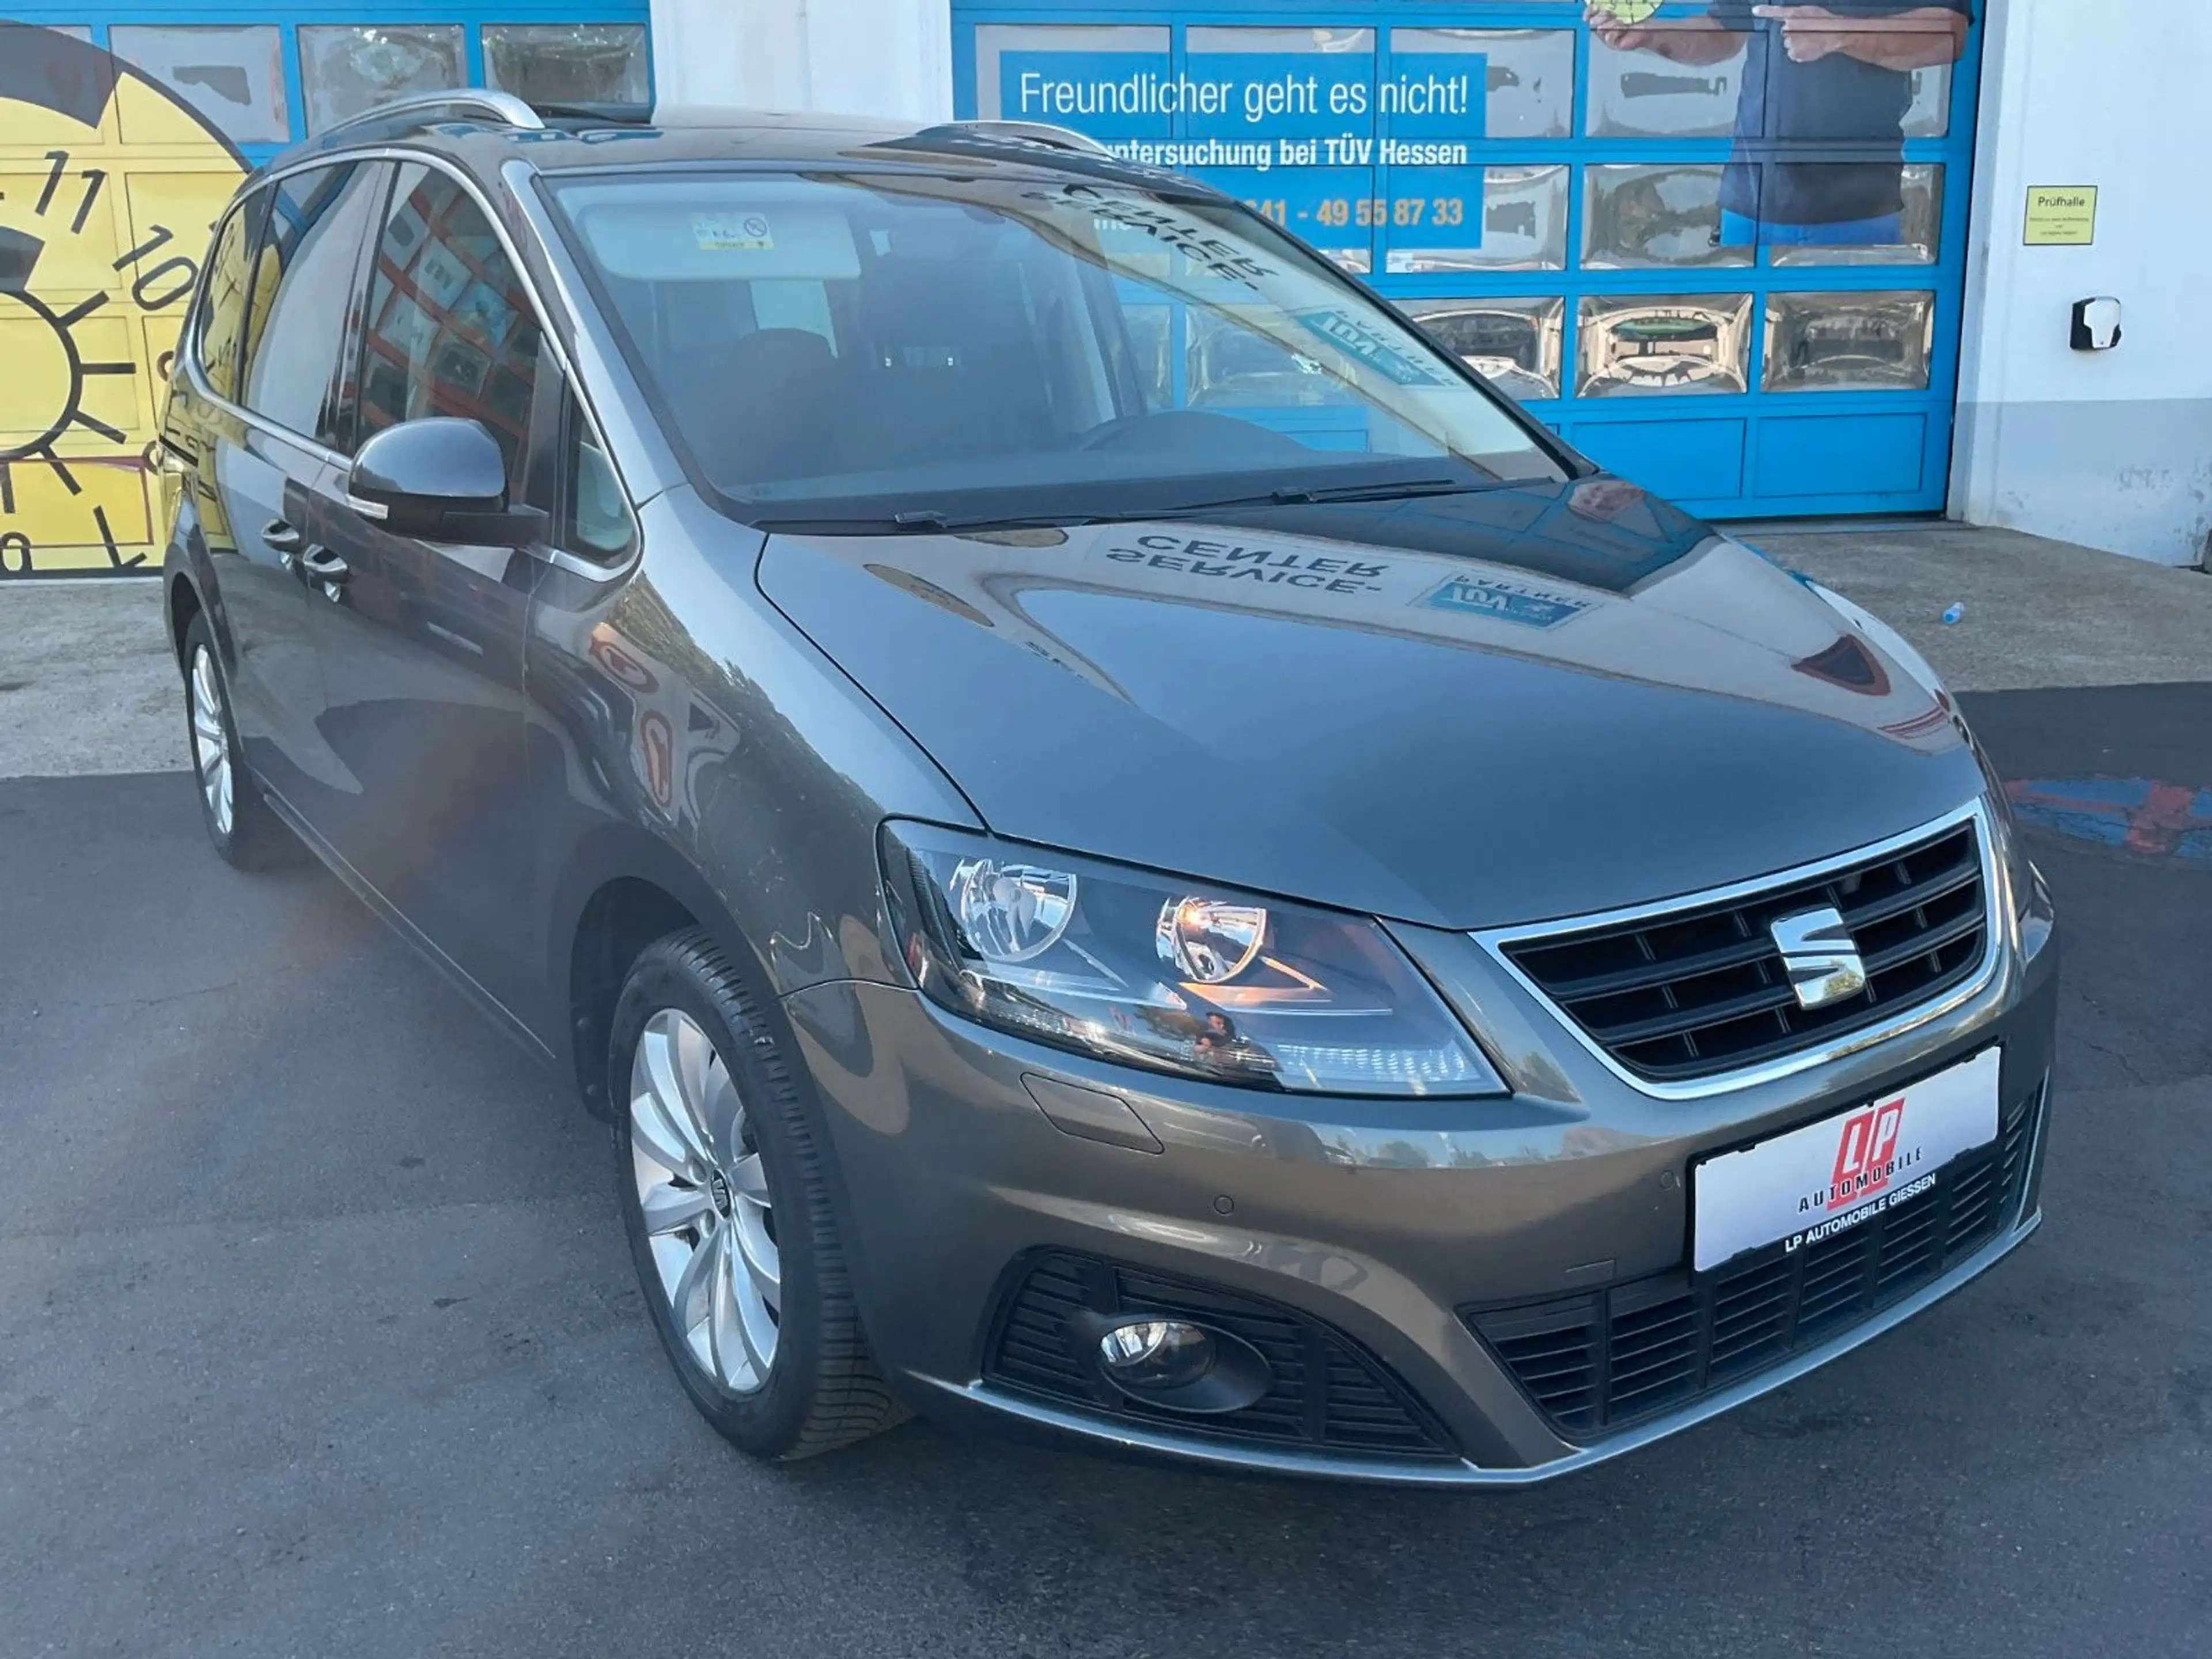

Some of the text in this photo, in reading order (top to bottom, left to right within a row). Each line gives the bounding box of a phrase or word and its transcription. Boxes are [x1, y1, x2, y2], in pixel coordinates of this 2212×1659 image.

[1021, 73, 1468, 123] Freundlicher geht es nicht!
[1279, 139, 1316, 165] bei
[1324, 132, 1373, 165] TÜV
[1379, 139, 1468, 165] Hessen
[35, 150, 105, 235] 11
[1316, 199, 1350, 226] 49
[1355, 199, 1387, 226] 55
[1393, 199, 1426, 225] 87
[1432, 199, 1464, 225] 33
[1797, 1145, 1923, 1213] AUTOMOBILE
[1785, 1173, 1936, 1253] LP AUTOMOBILE GIESSEN
